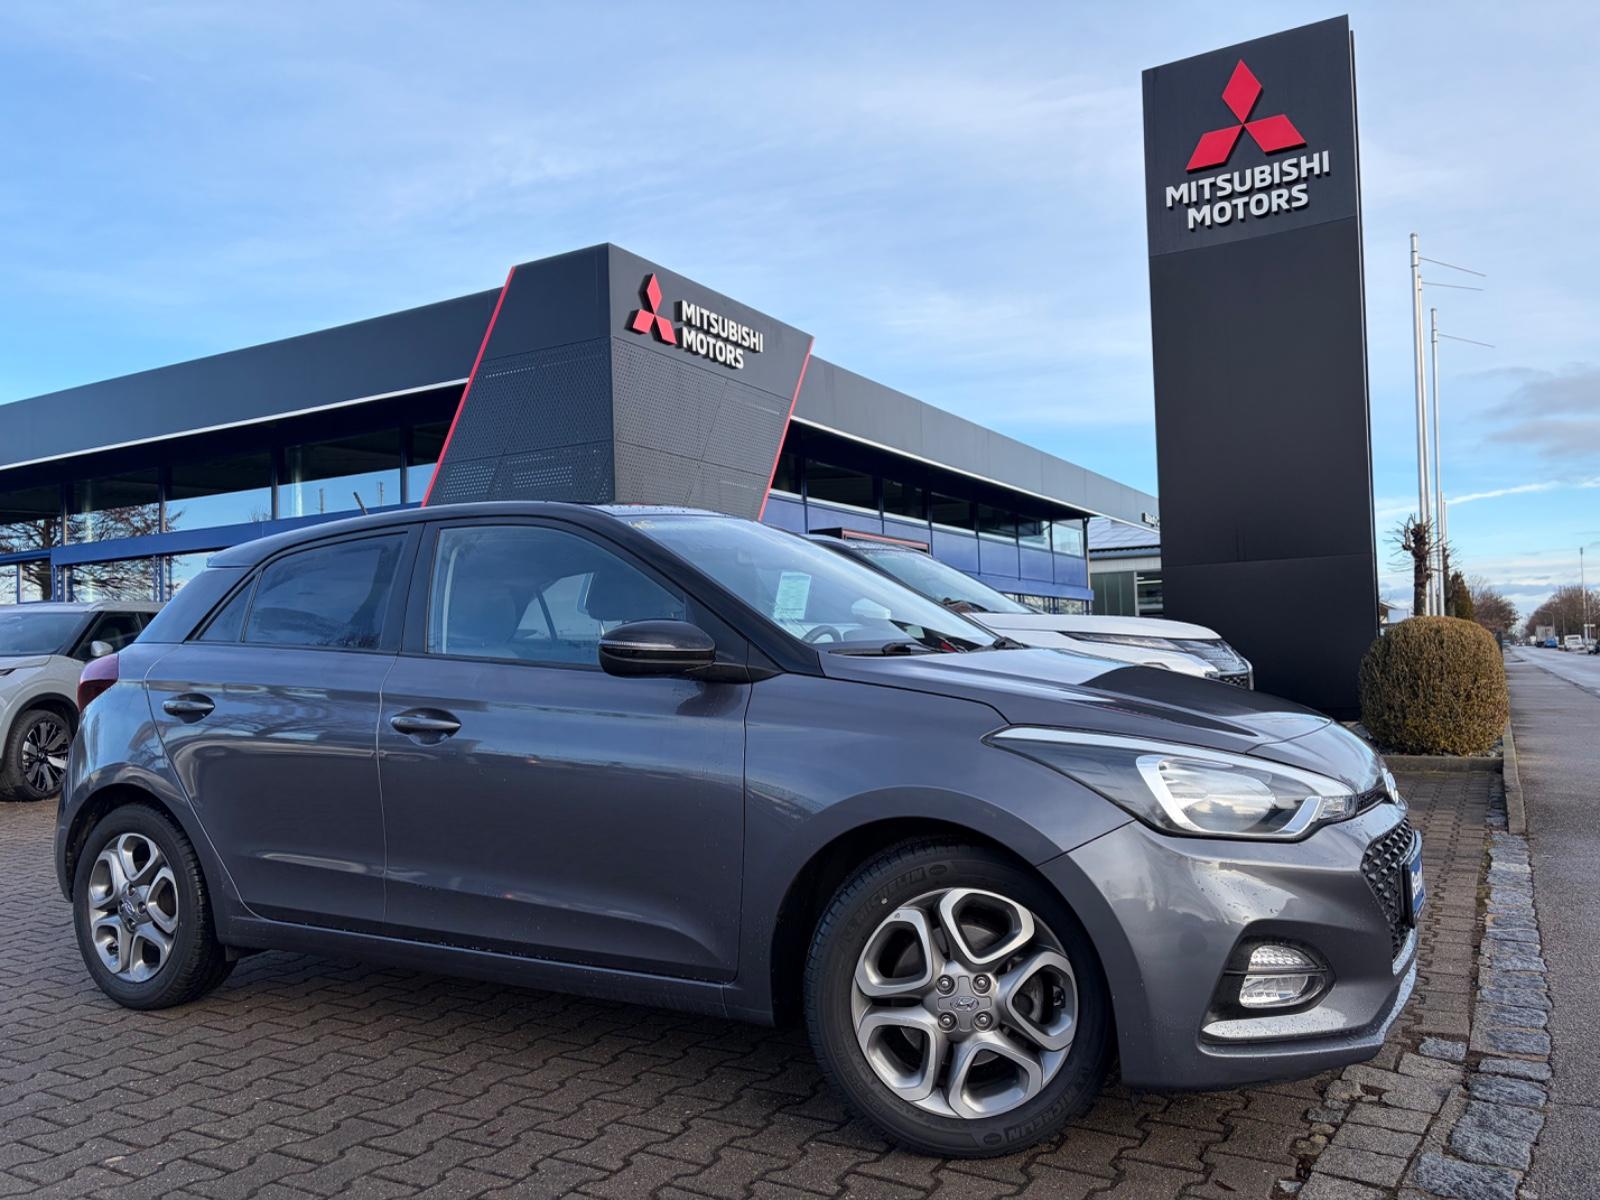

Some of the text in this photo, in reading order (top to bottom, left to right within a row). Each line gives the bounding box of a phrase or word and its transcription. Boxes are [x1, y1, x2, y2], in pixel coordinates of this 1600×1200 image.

[1166, 151, 1330, 208] MITSUBISHI
[1188, 184, 1309, 229] MOTORS
[682, 300, 763, 353] MITSUBISHI
[682, 327, 744, 369] MOTORS
[852, 866, 925, 924] MICHELIN
[1006, 1084, 1079, 1142] MICHELIN
